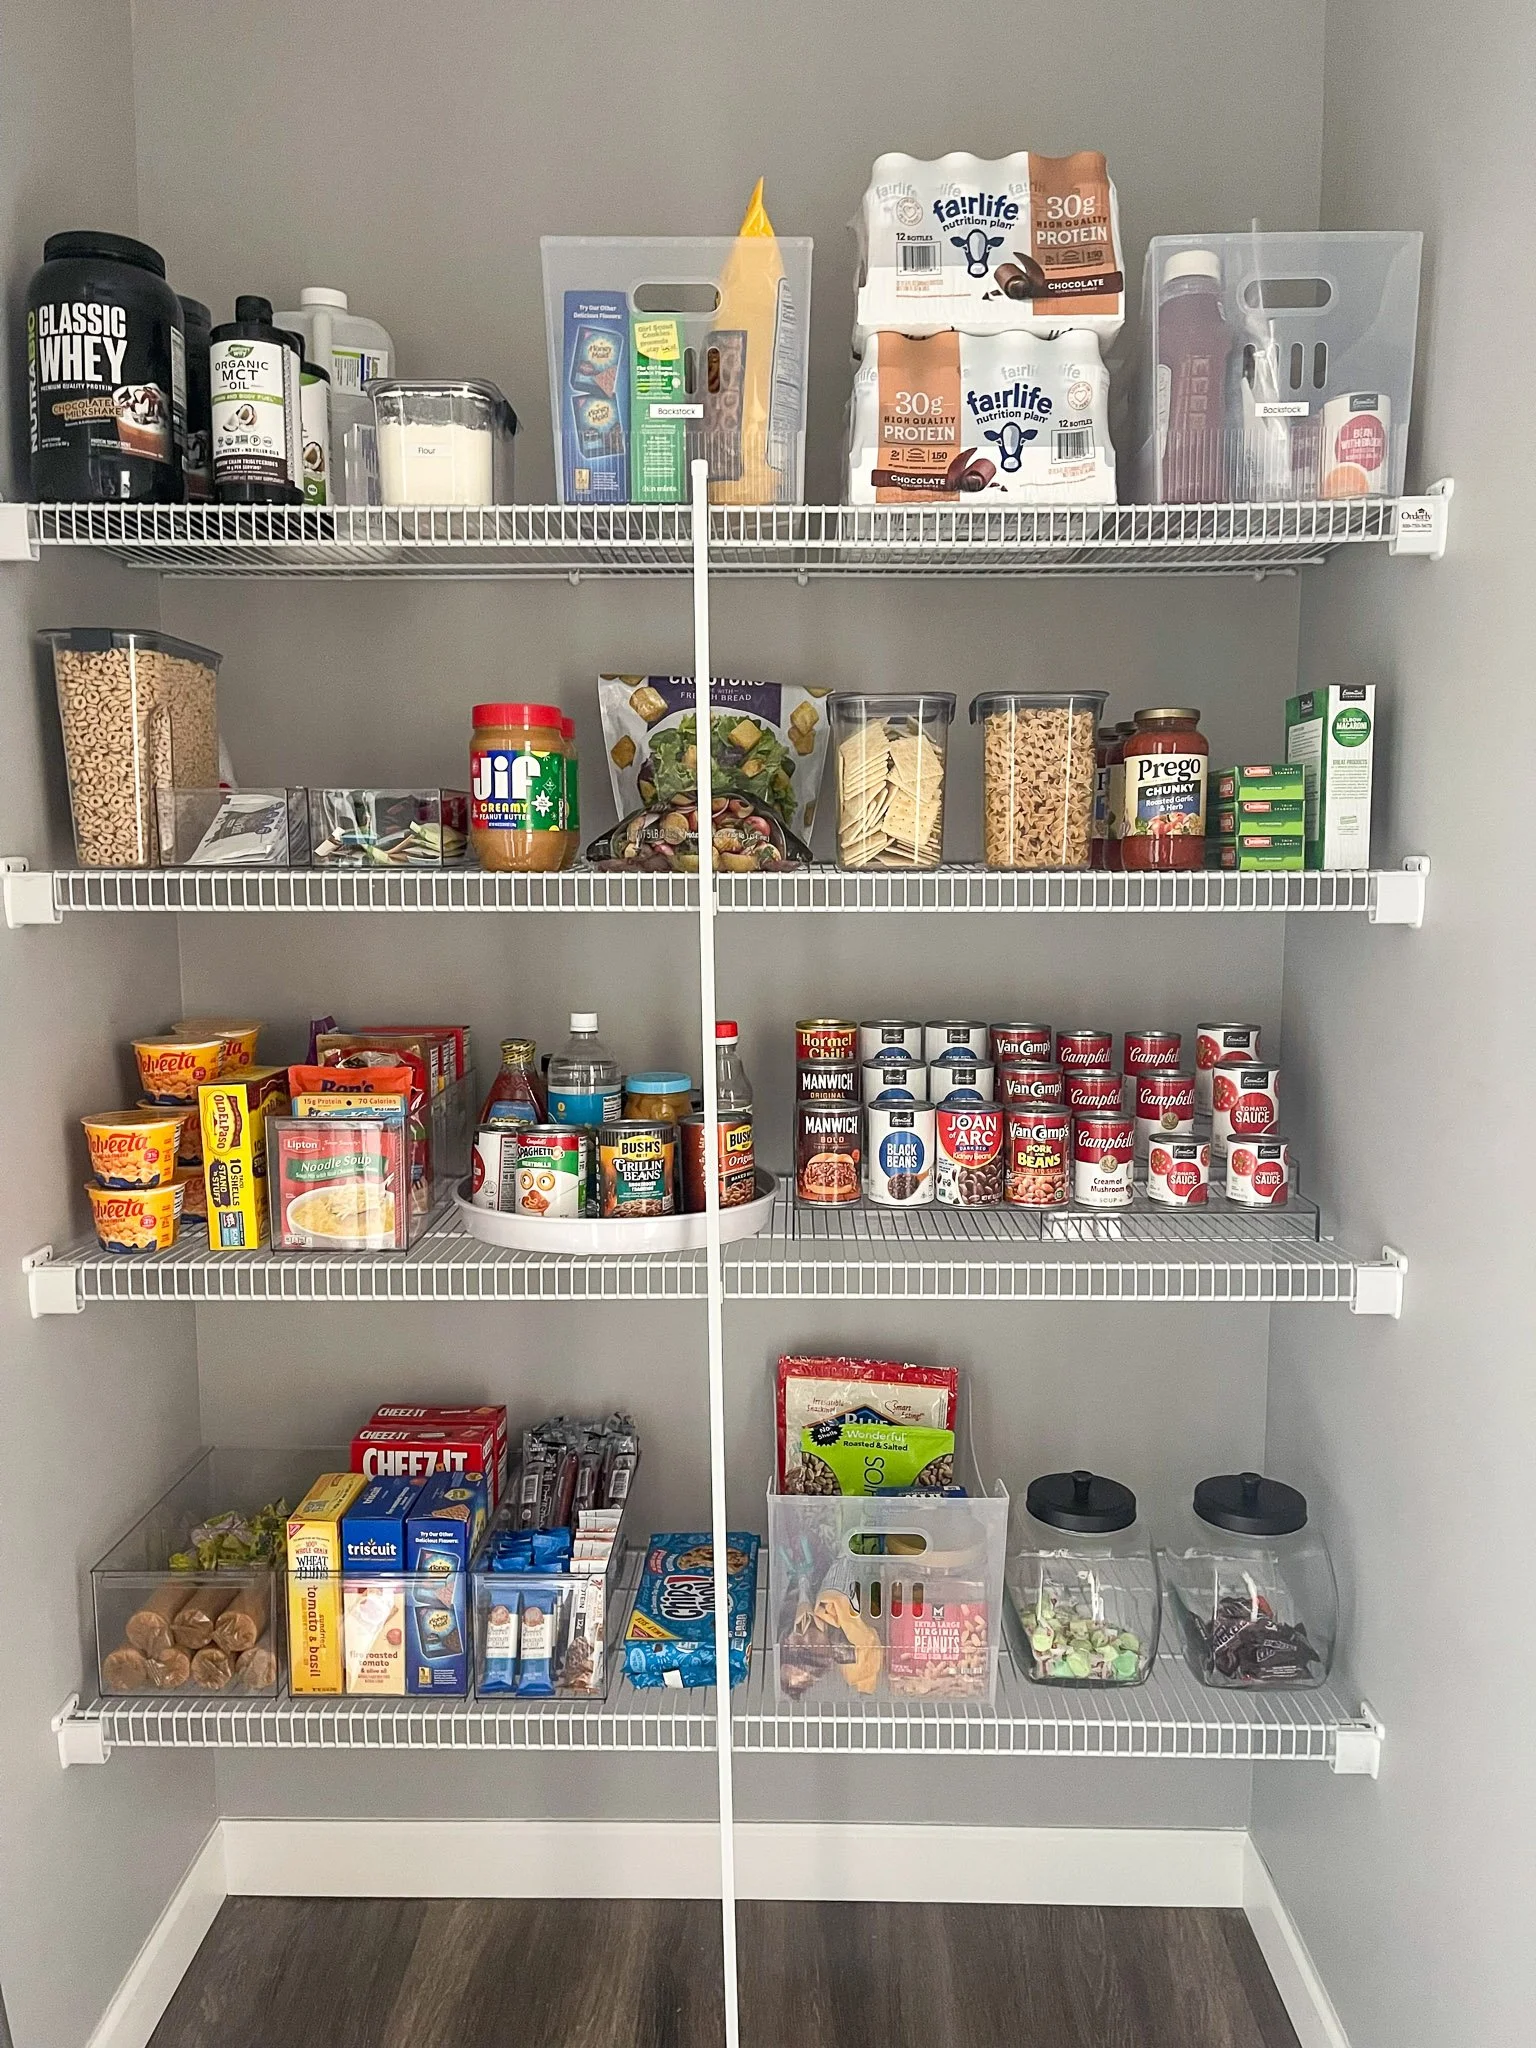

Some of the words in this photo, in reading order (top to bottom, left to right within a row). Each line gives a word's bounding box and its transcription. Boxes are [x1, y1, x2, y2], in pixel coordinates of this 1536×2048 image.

[1047, 194, 1096, 219] 30g
[942, 216, 987, 232] nutrition
[1036, 220, 1062, 228] HIGH
[1065, 216, 1107, 227] QUALITY
[896, 232, 906, 241] 12
[1036, 226, 1107, 245] PROTEIN
[1047, 278, 1104, 290] CHOCOLATE
[39, 302, 127, 338] CLASSIC
[39, 334, 128, 384] WHEY
[214, 360, 269, 371] ORGANIC
[222, 369, 259, 381] MCT
[62, 382, 85, 390] QUALITY
[86, 383, 113, 391] PROTEIN
[229, 381, 250, 390] OIL
[53, 401, 110, 414] CHOCOLATE
[895, 391, 944, 415] 30g
[65, 407, 122, 419] MILKSHAKE
[1263, 406, 1301, 414] Backstock
[883, 416, 910, 424] HIGH
[912, 416, 956, 425] QUALITY
[976, 409, 1021, 425] nutrition
[1058, 420, 1069, 428] 12
[1069, 419, 1093, 427] BOTTLES
[884, 425, 955, 441] PROTEIN
[418, 446, 436, 455] Flour
[931, 452, 948, 460] 150
[890, 475, 946, 485] CHOCOLATE
[720, 694, 752, 702] BREAD
[1336, 722, 1368, 730] MACARONI
[1138, 758, 1201, 783] Prego
[473, 755, 541, 801] Jif
[1145, 783, 1195, 797] CHUNKY
[1145, 796, 1174, 807] Roasted
[1174, 795, 1194, 803] Garlic
[480, 802, 528, 813] CREAMY
[802, 1033, 852, 1046] Hormel
[808, 1047, 845, 1059] Chili
[321, 1080, 375, 1093] Ben's
[802, 1072, 853, 1091] MANWICH
[213, 1094, 226, 1113] OLD
[219, 1113, 229, 1125] EL
[1235, 1111, 1270, 1123] SAUCE
[805, 1116, 859, 1134] MANWICH
[947, 1115, 997, 1132] JOAN
[955, 1131, 994, 1146] ARC
[287, 1140, 318, 1150] Lipton
[621, 1142, 661, 1155] BUSH'S
[886, 1143, 918, 1156] BLACK
[1026, 1144, 1052, 1153] PORK
[886, 1156, 918, 1168] BEANS
[952, 1153, 973, 1161] Kidney
[1017, 1152, 1061, 1168] BEANS
[229, 1158, 242, 1174] 10
[300, 1158, 342, 1172] Noodle
[343, 1155, 372, 1166] Soup
[612, 1159, 664, 1171] GRILLIN'
[218, 1164, 228, 1193] STAND
[623, 1170, 661, 1182] BEANS
[731, 1174, 747, 1182] BAKED
[1170, 1175, 1197, 1185] SAUCE
[1255, 1175, 1281, 1185] SAUCE
[212, 1177, 221, 1205] STUFF
[230, 1174, 240, 1207] SHELLS
[817, 1430, 838, 1440] Shells
[846, 1430, 904, 1442] Wonderful
[843, 1440, 875, 1448] Roasted
[883, 1443, 908, 1451] Salted
[347, 1541, 397, 1556] triscuit
[295, 1556, 329, 1567] WHEAT
[664, 1582, 704, 1619] Chips
[307, 1585, 318, 1632] tomato
[318, 1614, 327, 1649] sundried
[913, 1627, 960, 1636] VIRGINIA
[914, 1635, 960, 1653] PEANUTS
[365, 1651, 398, 1659] roasted
[309, 1646, 321, 1677] basil
